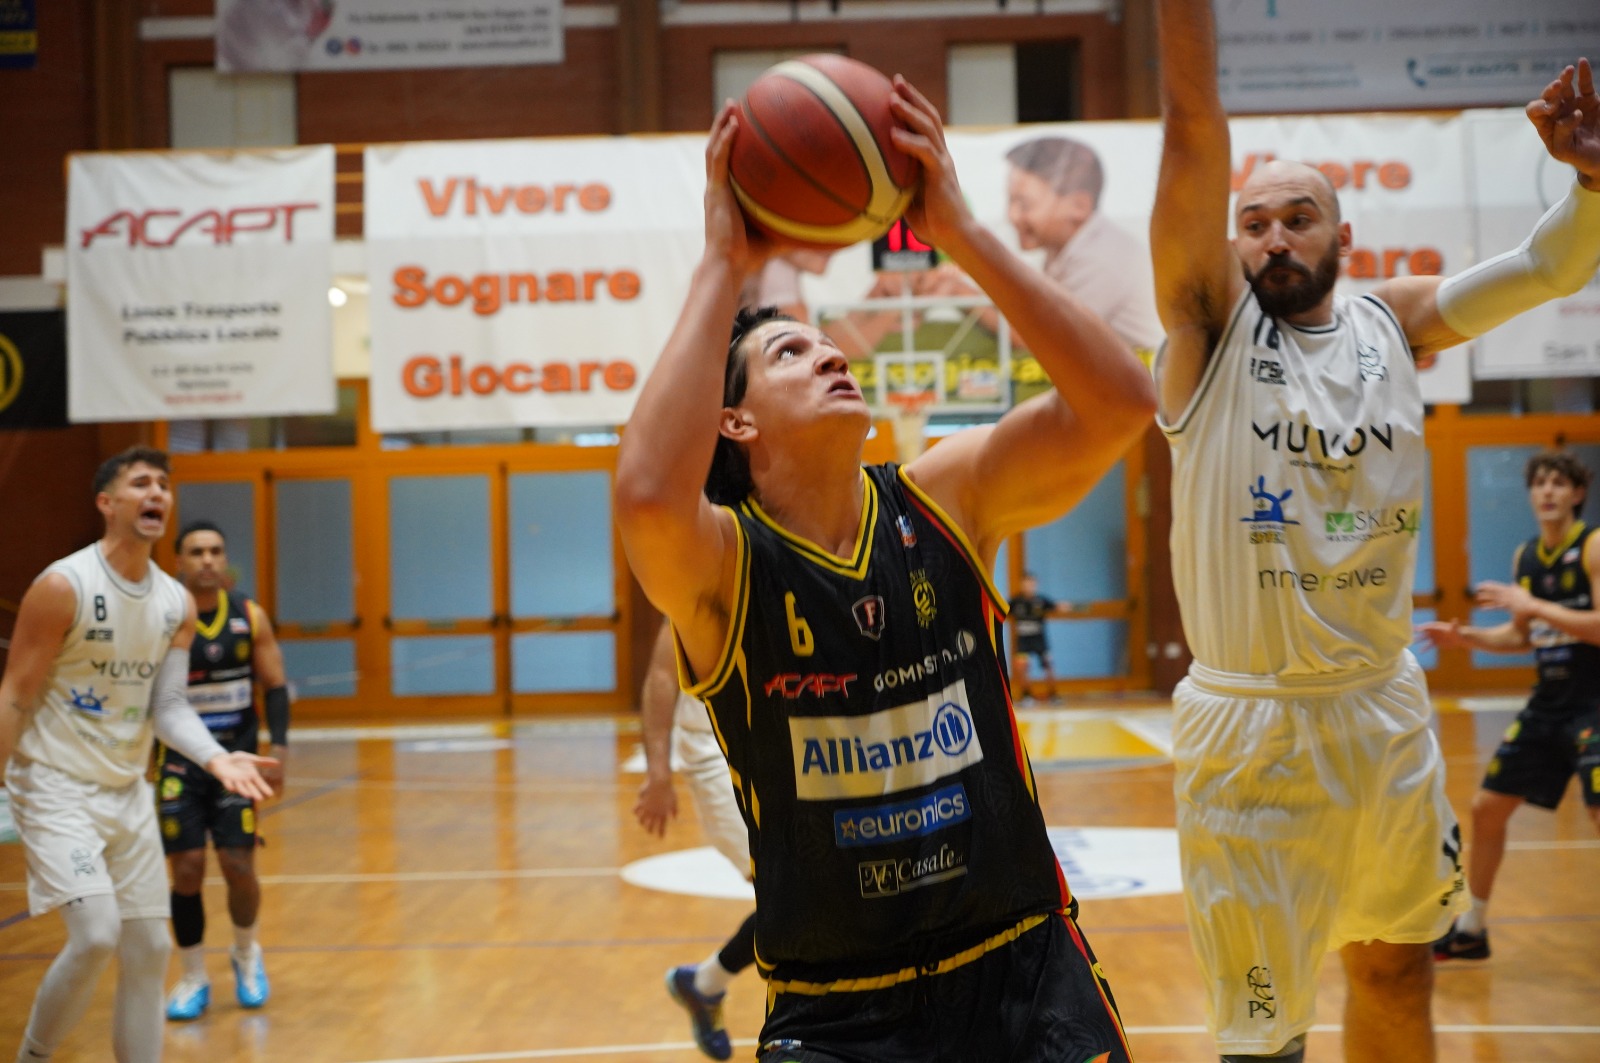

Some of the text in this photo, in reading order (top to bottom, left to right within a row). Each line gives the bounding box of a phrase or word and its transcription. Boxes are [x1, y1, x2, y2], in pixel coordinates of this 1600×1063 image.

[417, 177, 612, 218] Vivere
[81, 203, 319, 249] ACAPT
[392, 265, 641, 316] Sognare
[402, 355, 638, 398] Giocare
[785, 591, 814, 657] 6
[801, 731, 934, 776] Allianz
[859, 793, 966, 839] euronics
[898, 843, 955, 882] Casale
